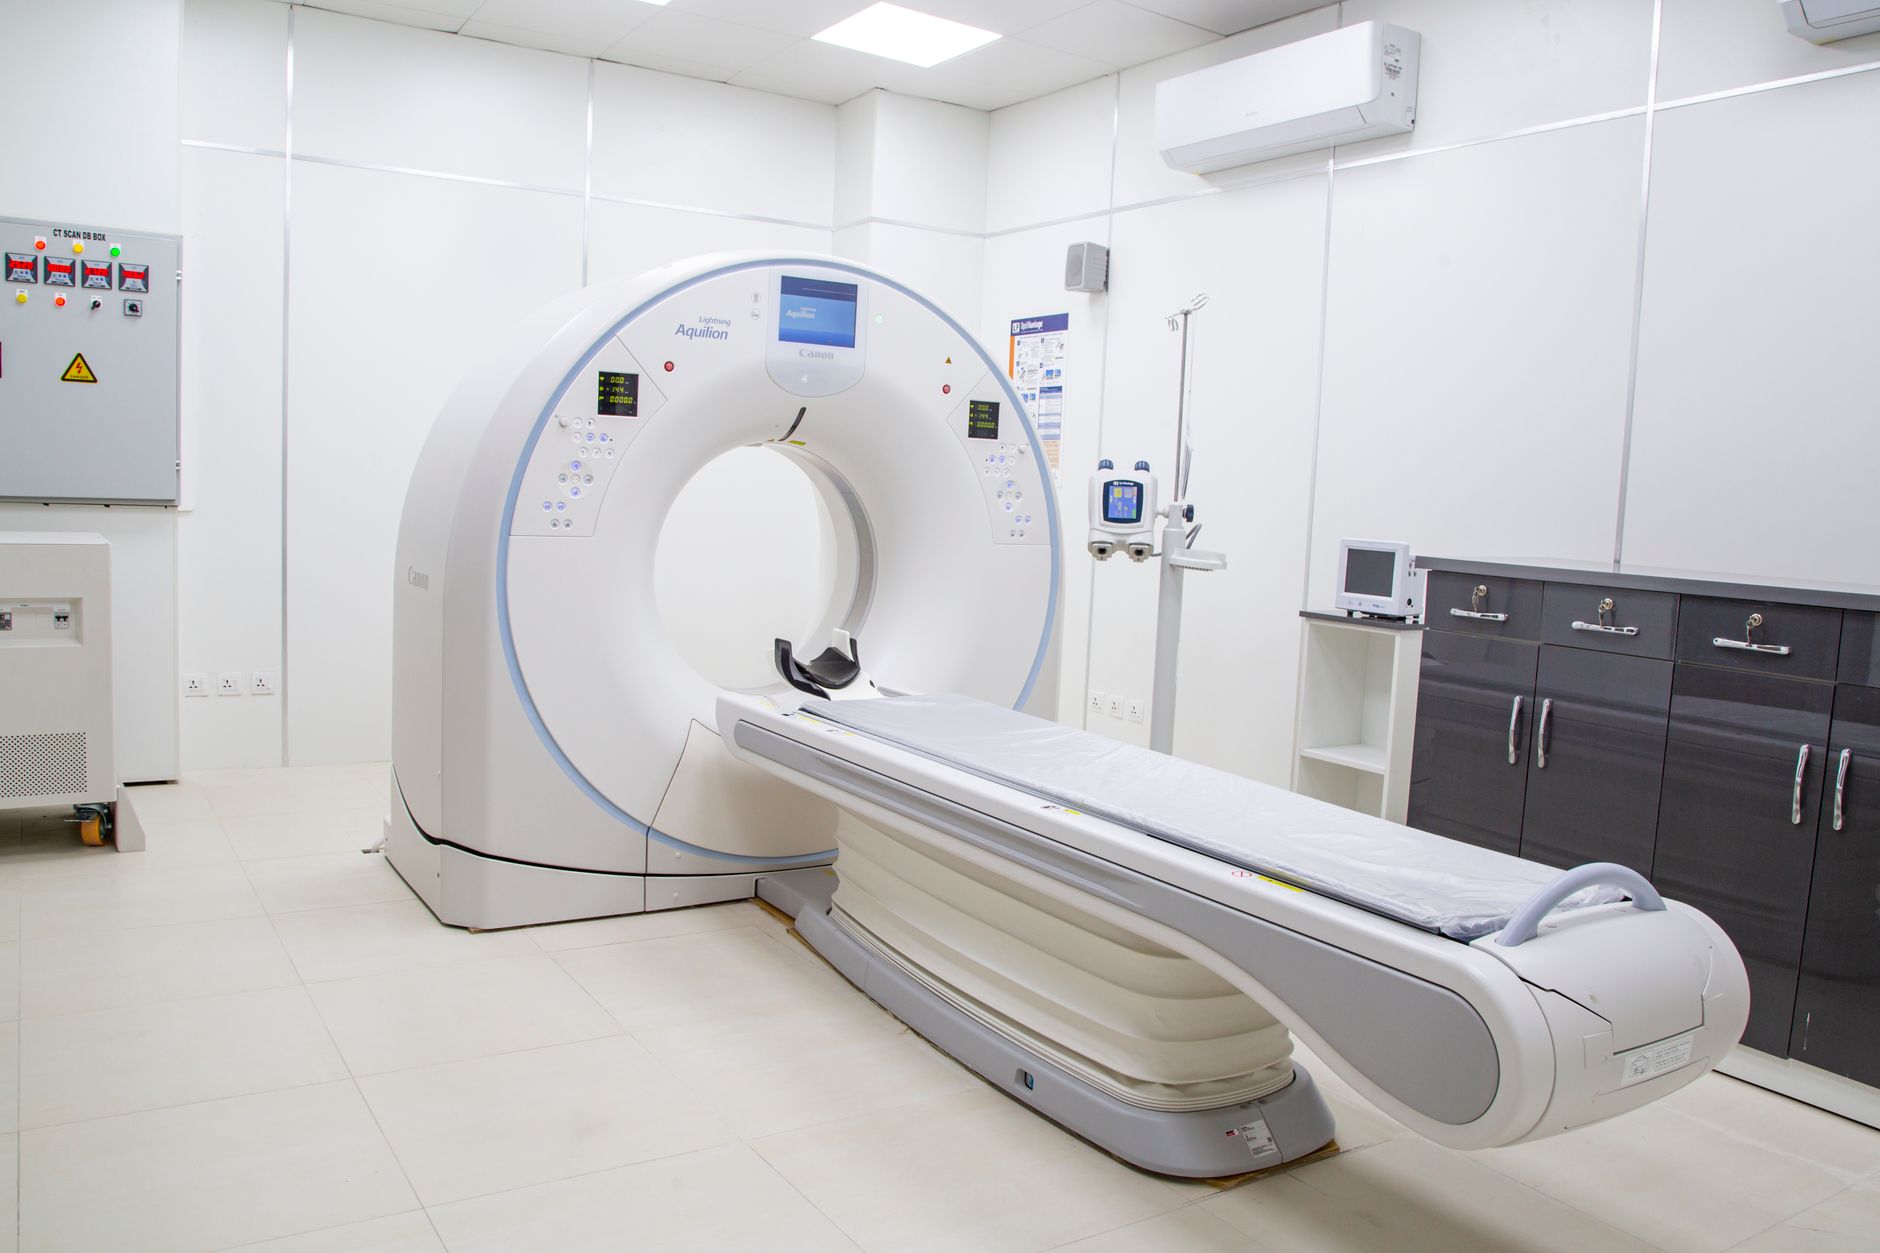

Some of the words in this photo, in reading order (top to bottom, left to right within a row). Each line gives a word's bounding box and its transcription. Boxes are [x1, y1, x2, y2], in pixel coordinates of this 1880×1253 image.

[53, 229, 62, 238] CT
[64, 230, 81, 239] SCAN
[82, 231, 92, 240] DB
[93, 232, 106, 241] BOX
[785, 309, 816, 320] Aquilion
[699, 316, 731, 327] Lightning
[675, 323, 728, 340] Aquilion
[798, 348, 834, 360] Canon
